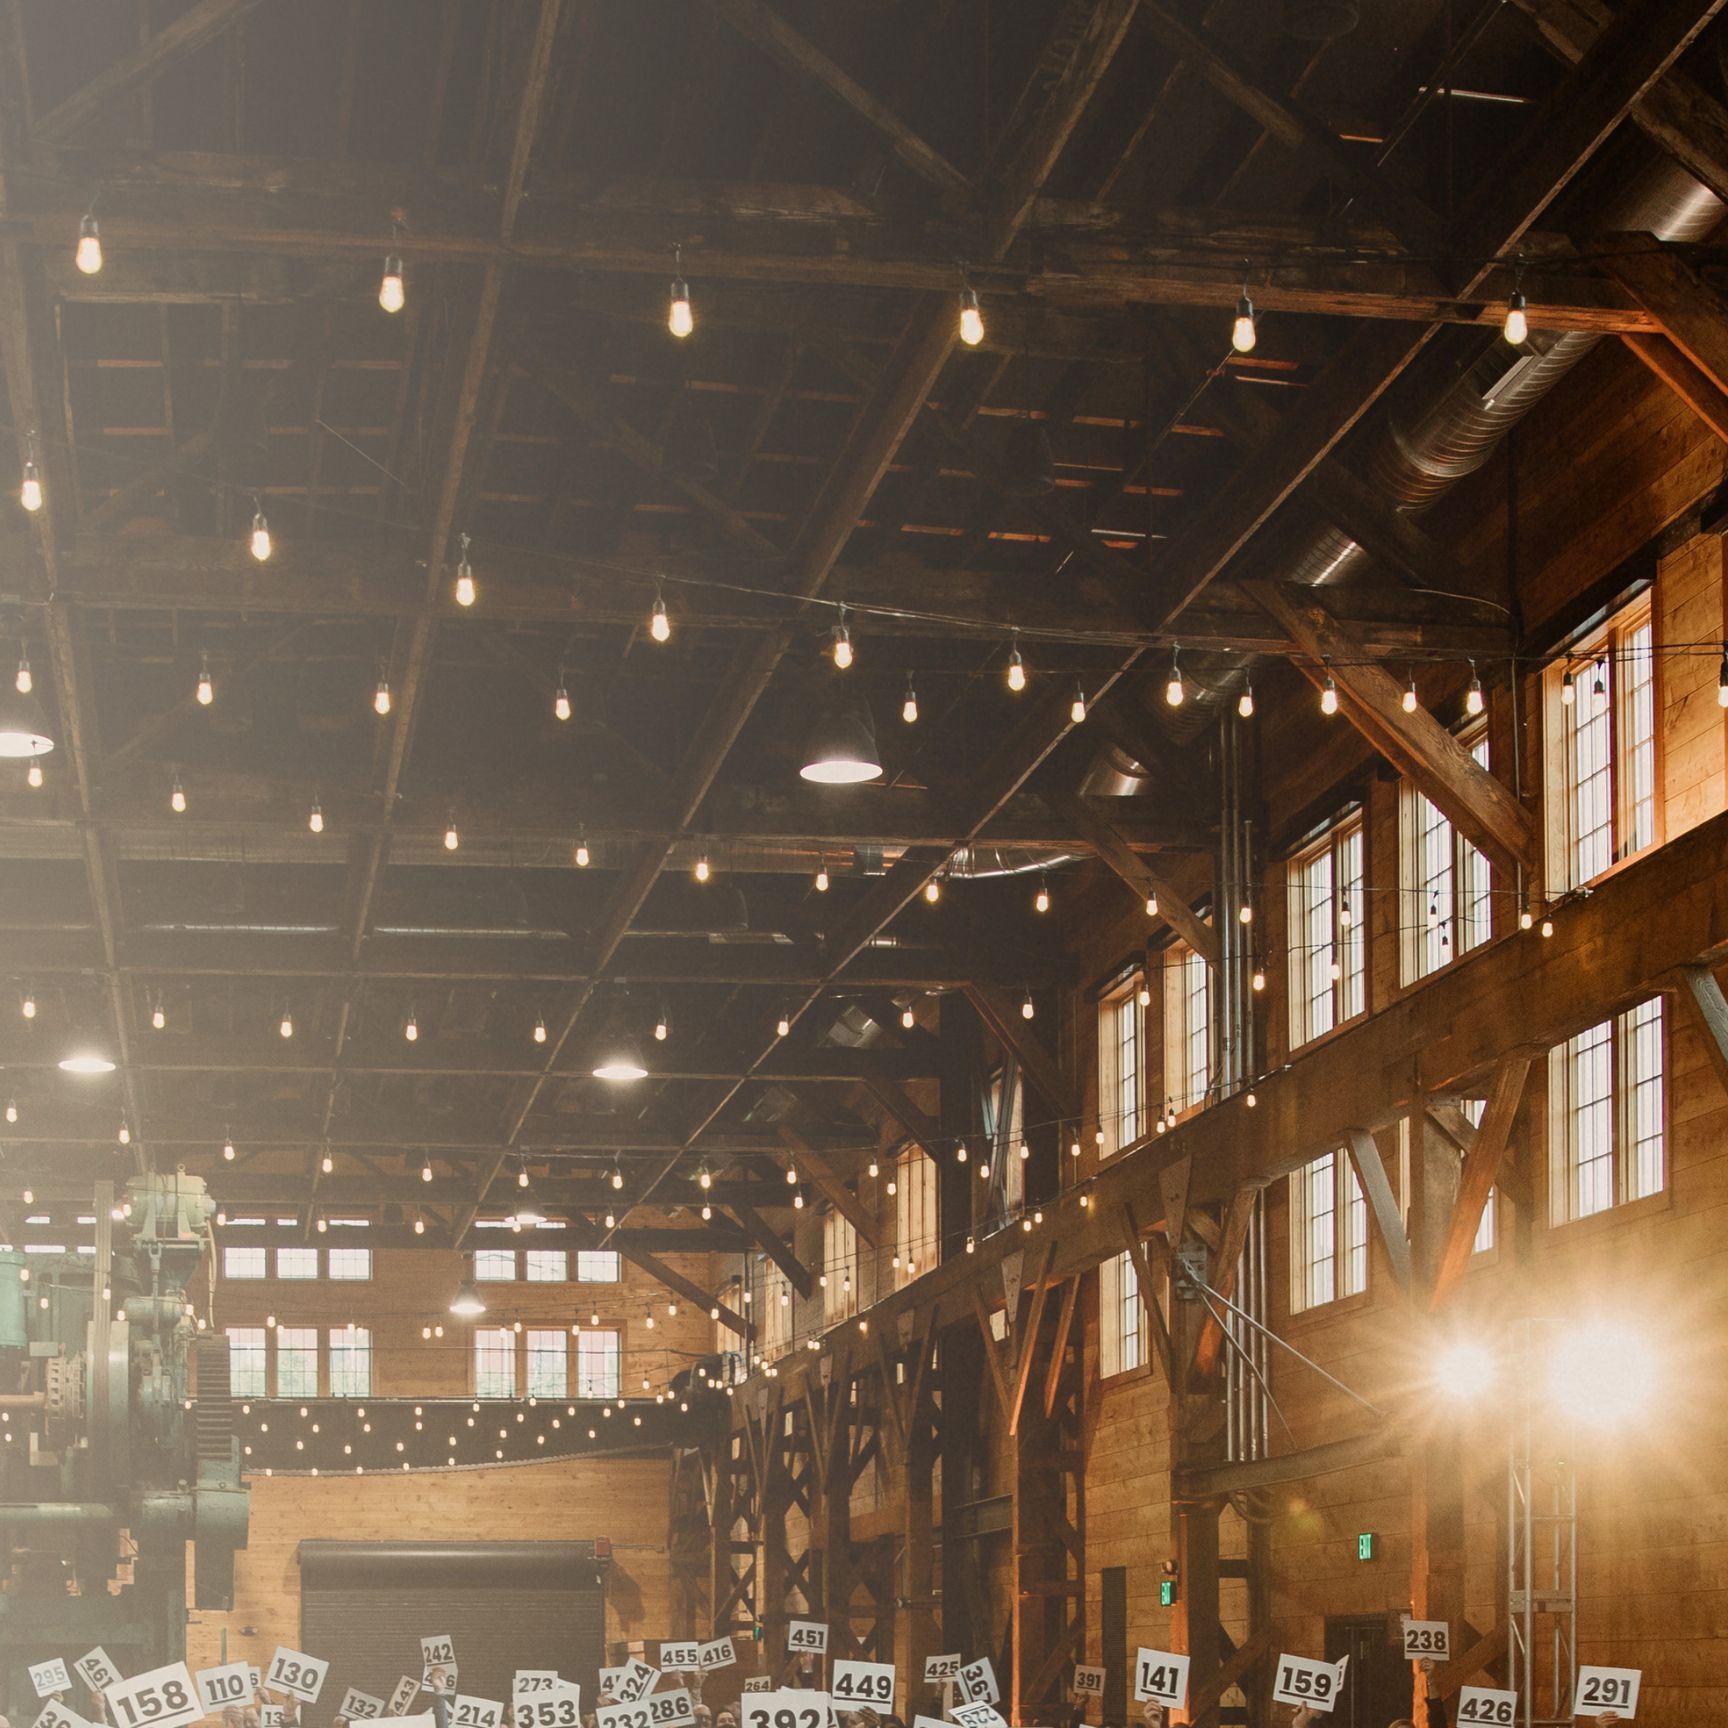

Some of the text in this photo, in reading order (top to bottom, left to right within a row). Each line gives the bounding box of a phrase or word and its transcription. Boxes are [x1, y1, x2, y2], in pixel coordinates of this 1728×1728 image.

[792, 1629, 824, 1646] 451
[1406, 1630, 1447, 1650] 238
[424, 1644, 453, 1662] 242
[662, 1649, 697, 1664] 455
[703, 1644, 732, 1663] 416
[34, 1666, 65, 1688] 295
[84, 1658, 115, 1689] 461
[277, 1658, 318, 1690] 130
[926, 1660, 960, 1676] 425
[1078, 1671, 1101, 1688] 391
[1142, 1662, 1178, 1693] 141
[206, 1674, 244, 1701] 110
[426, 1674, 455, 1688] 46
[620, 1664, 650, 1702] 324
[746, 1680, 770, 1692] 264
[836, 1673, 892, 1699] 449
[1282, 1666, 1332, 1697] 159
[1584, 1676, 1631, 1704] 291
[117, 1680, 188, 1724] 158
[347, 1696, 378, 1718] 132
[394, 1680, 416, 1713] 443
[650, 1696, 690, 1720] 286
[264, 1711, 284, 1724] 13
[456, 1704, 496, 1728] 214
[518, 1700, 576, 1728] 353
[1460, 1698, 1512, 1722] 426
